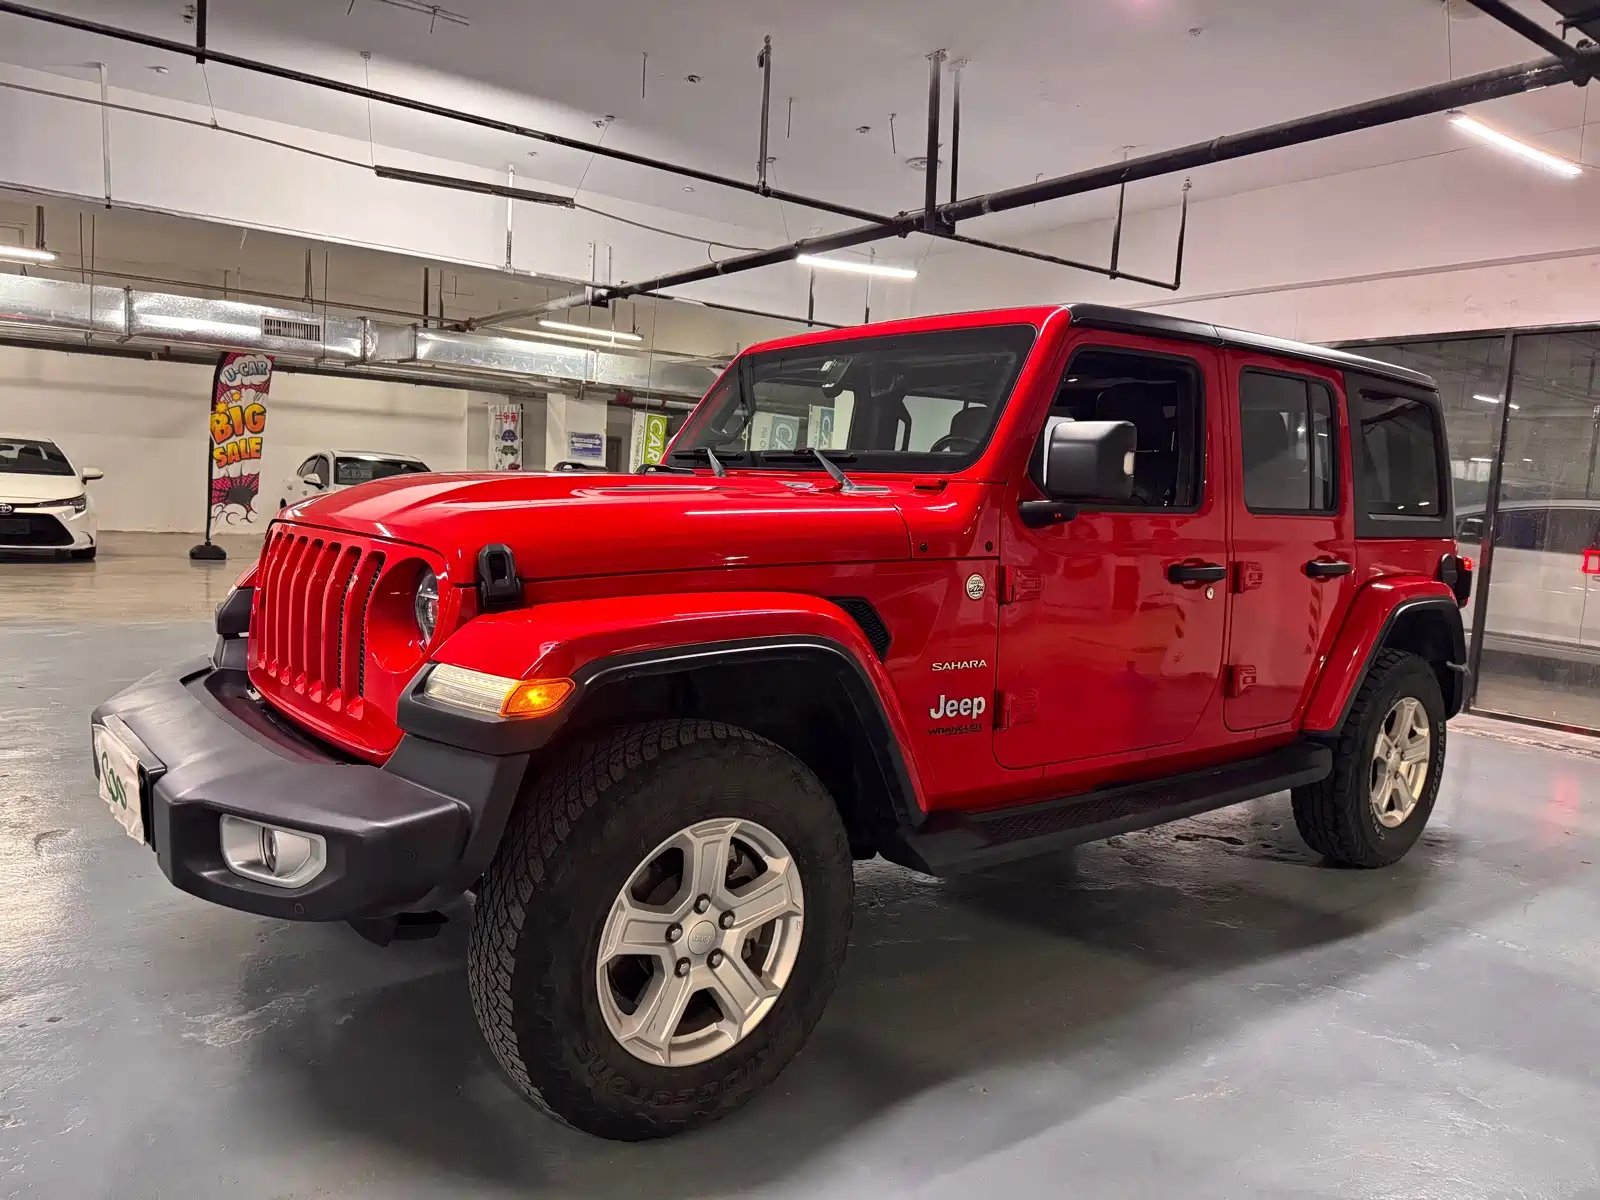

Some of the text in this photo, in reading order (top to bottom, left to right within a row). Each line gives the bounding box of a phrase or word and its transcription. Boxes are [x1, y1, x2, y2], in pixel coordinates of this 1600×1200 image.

[224, 360, 268, 382] U-CAR
[210, 403, 267, 444] BIG
[213, 437, 263, 468] SALE
[648, 418, 664, 462] CAR
[931, 659, 987, 672] SAHARA
[930, 694, 986, 720] Jeep
[928, 723, 983, 735] WRANGLER
